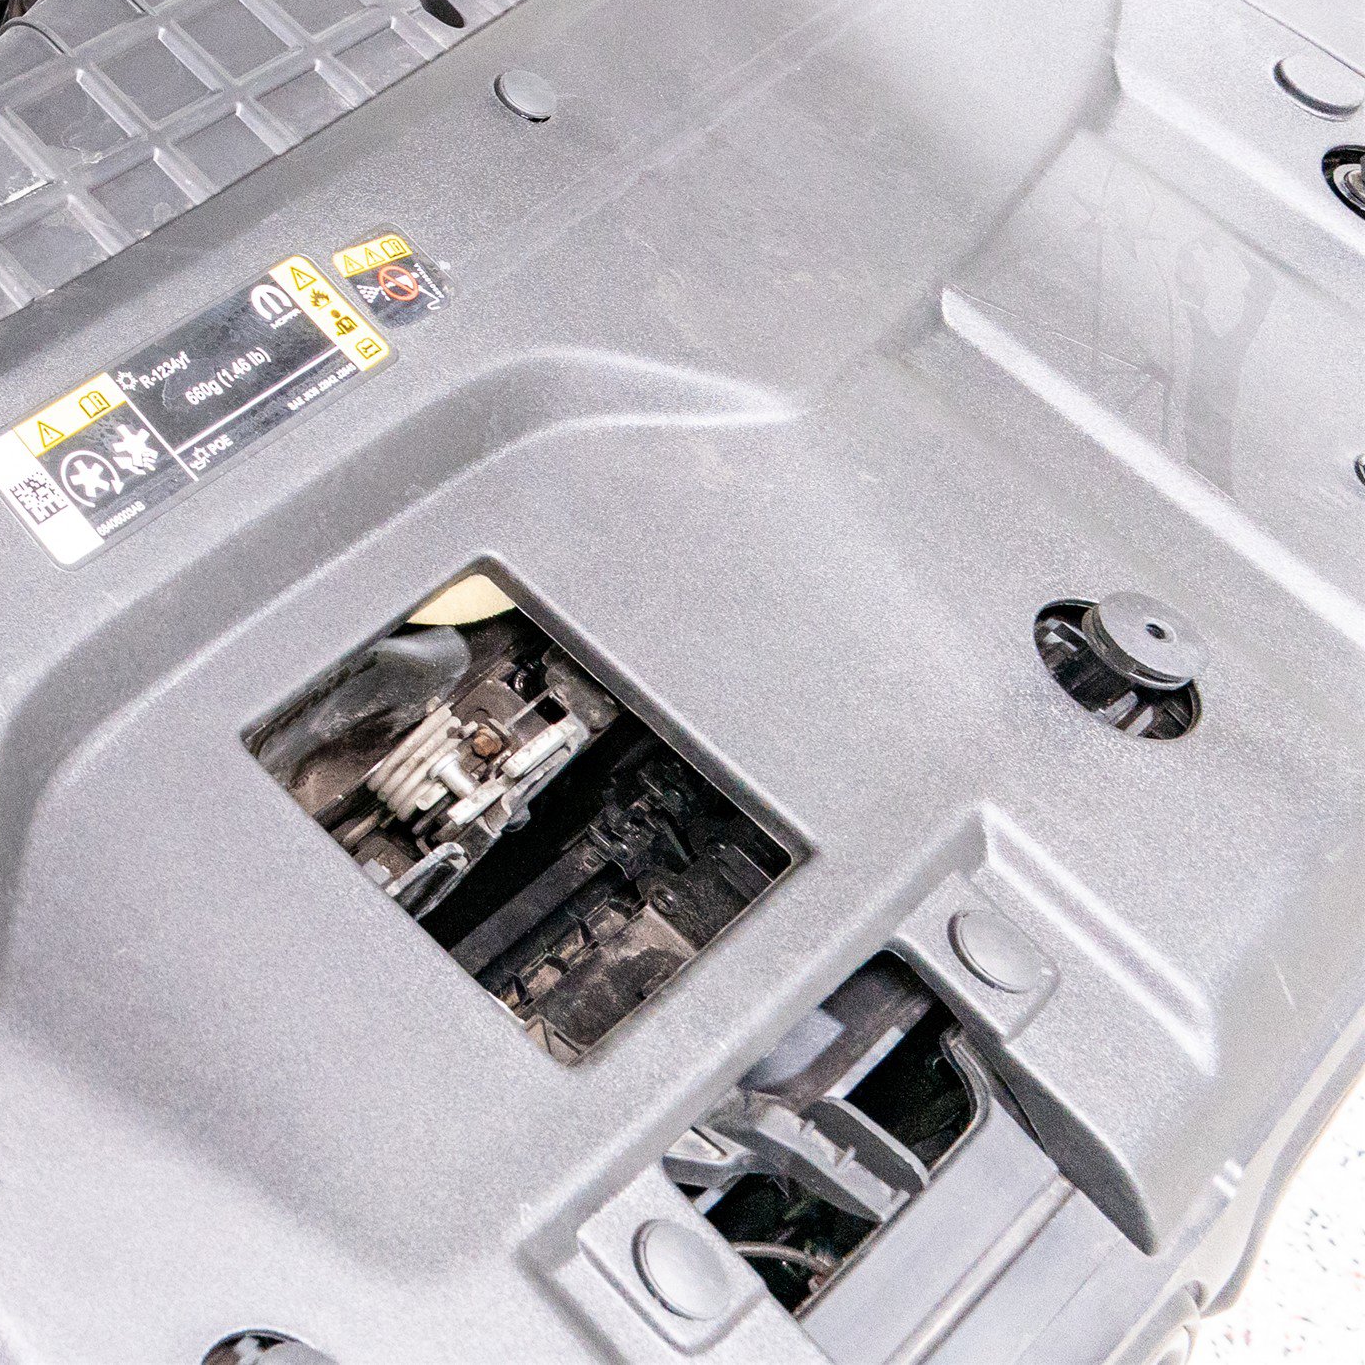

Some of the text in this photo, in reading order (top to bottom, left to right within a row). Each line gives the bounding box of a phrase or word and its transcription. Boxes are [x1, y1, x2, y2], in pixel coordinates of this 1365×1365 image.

[138, 351, 191, 389] R-1234yf
[185, 346, 272, 405] 660g (1.46 lb)
[207, 434, 234, 455] POE
